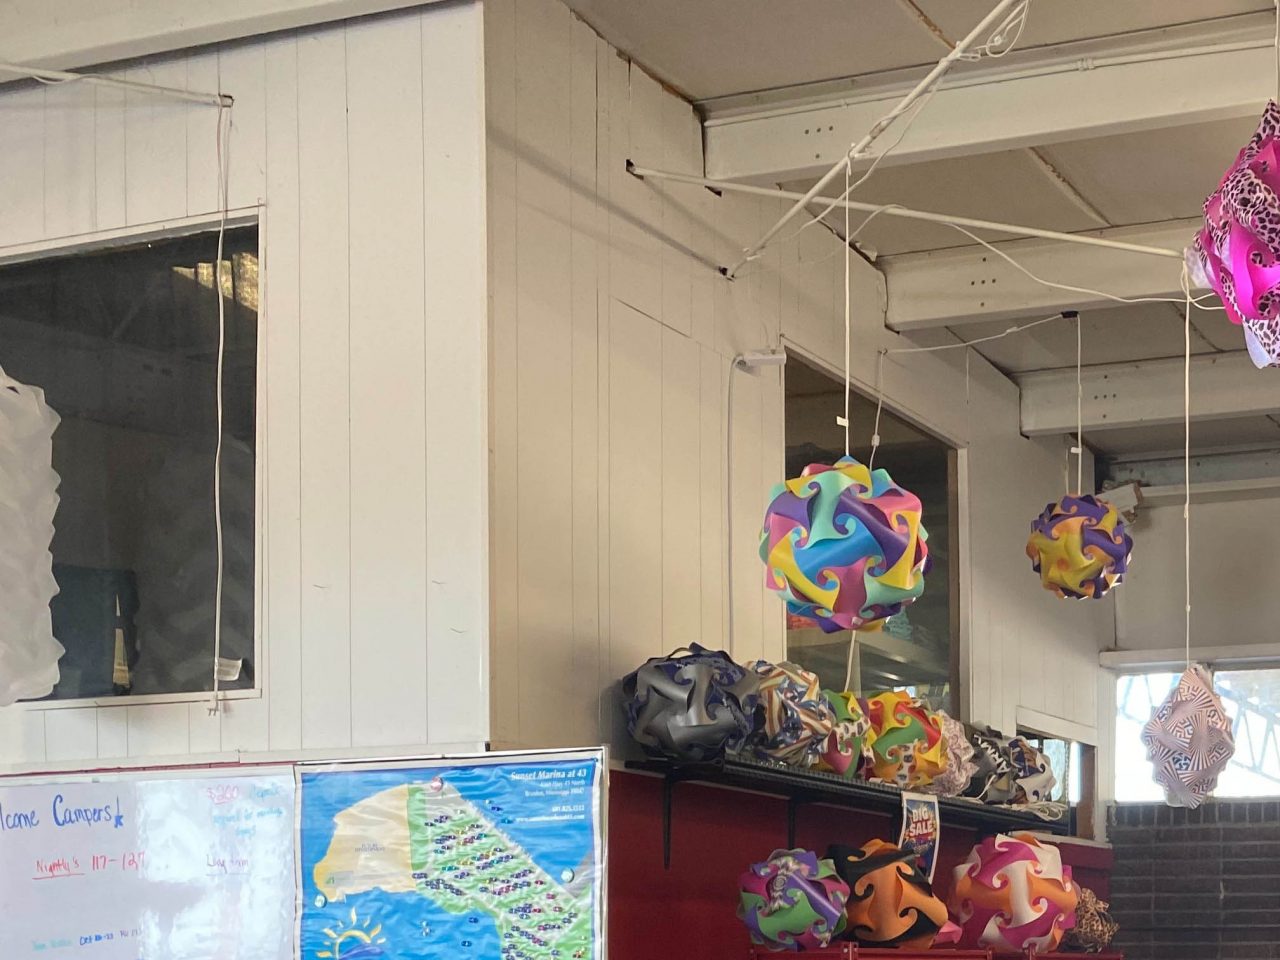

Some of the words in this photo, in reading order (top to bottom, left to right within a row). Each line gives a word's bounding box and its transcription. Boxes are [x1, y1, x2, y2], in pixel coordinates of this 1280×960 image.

[511, 771, 538, 780] Sunset
[538, 769, 566, 779] Marina
[567, 769, 576, 778] at
[577, 768, 587, 777] 43
[909, 820, 934, 836] SALE
